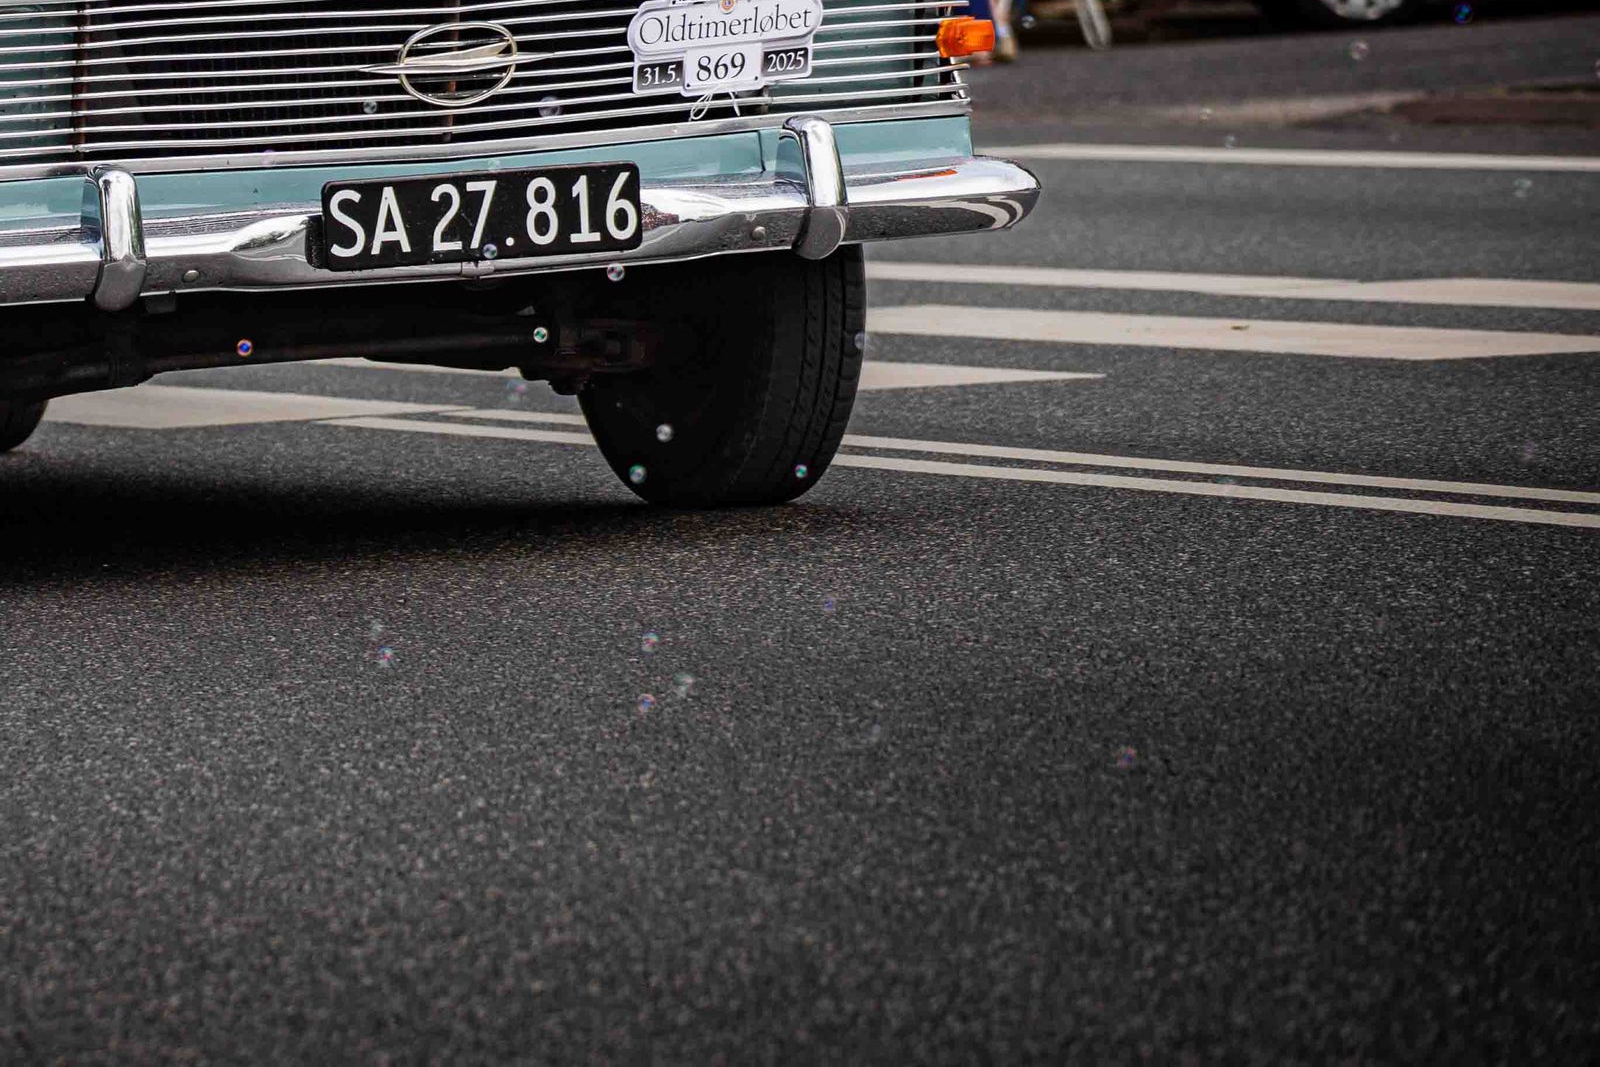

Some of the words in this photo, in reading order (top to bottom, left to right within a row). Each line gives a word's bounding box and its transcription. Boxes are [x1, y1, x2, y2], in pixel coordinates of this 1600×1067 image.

[639, 4, 812, 45] Oldtimerløbet
[642, 64, 681, 86] 31.5.
[696, 52, 746, 82] 869
[767, 50, 805, 72] 2025
[329, 185, 411, 258] SA
[430, 171, 637, 252] 27.816
